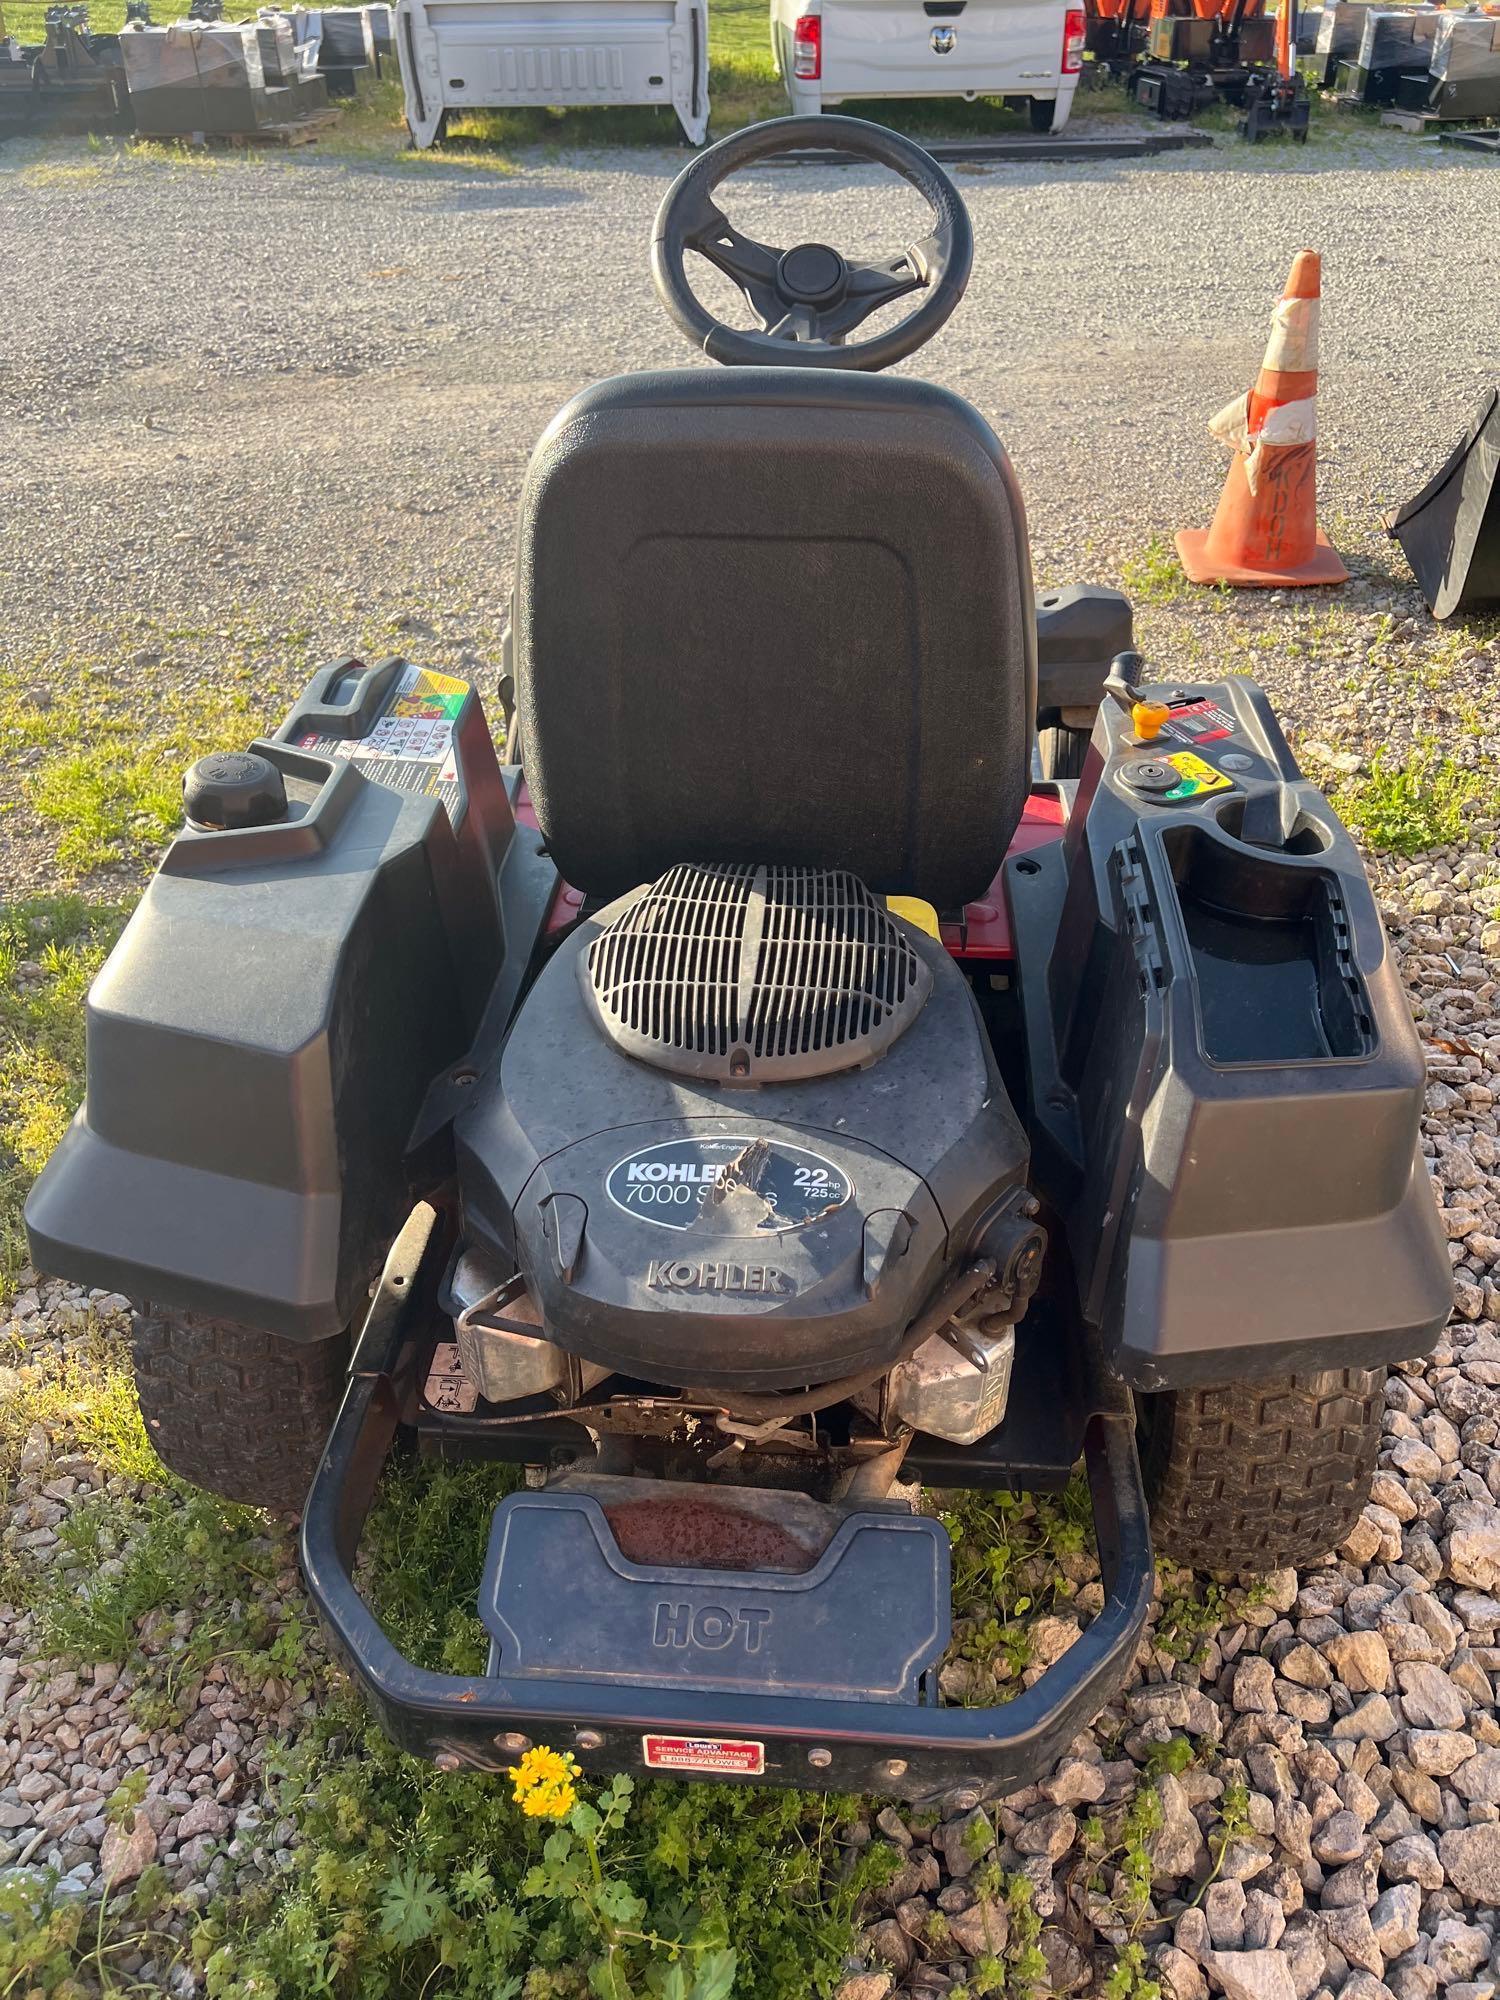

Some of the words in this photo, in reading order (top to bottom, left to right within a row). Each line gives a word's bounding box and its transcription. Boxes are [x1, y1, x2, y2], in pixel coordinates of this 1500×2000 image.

[625, 1183, 692, 1205] 7000
[648, 1260, 786, 1295] KOHLER
[652, 1602, 773, 1653] HOT
[655, 1745, 695, 1755] SERVICE
[696, 1748, 753, 1758] ADVANTAGE
